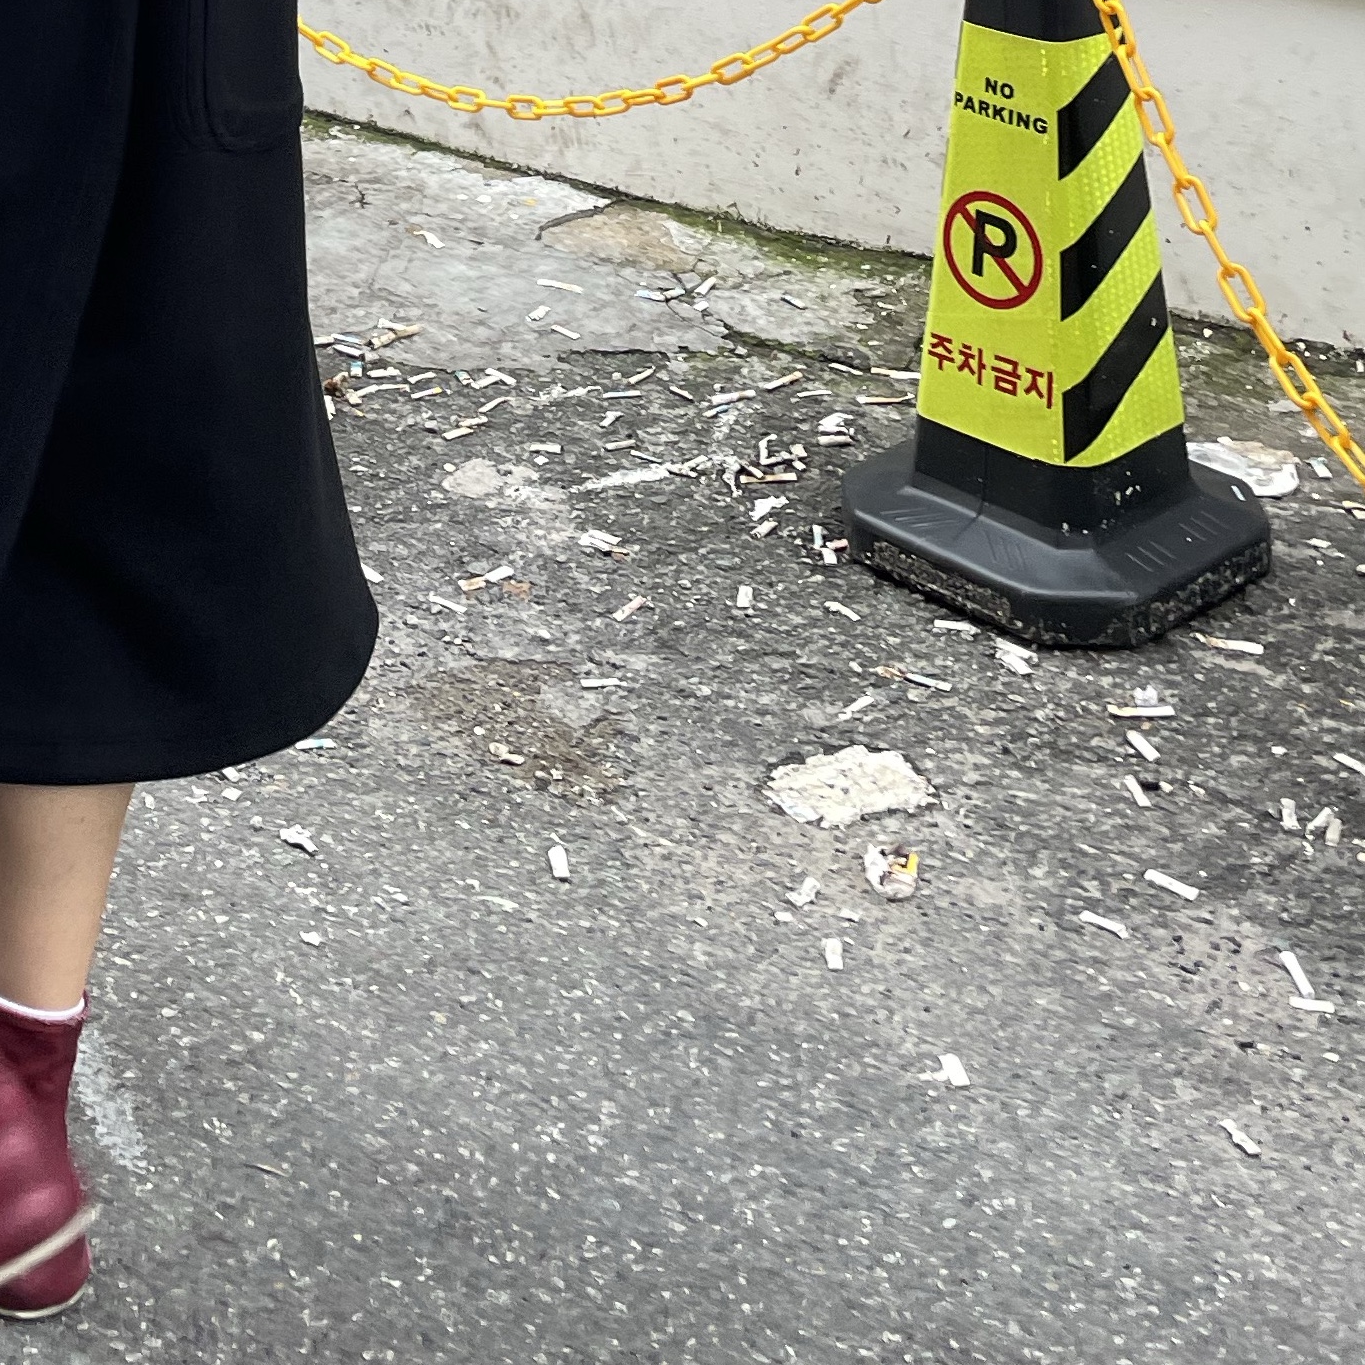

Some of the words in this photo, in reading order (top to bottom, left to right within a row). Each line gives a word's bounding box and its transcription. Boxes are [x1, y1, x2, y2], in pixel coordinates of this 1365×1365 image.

[954, 91, 1049, 135] PARKING
[984, 76, 1015, 100] NO
[971, 209, 1018, 277] P
[927, 331, 1054, 409] 주차금지
